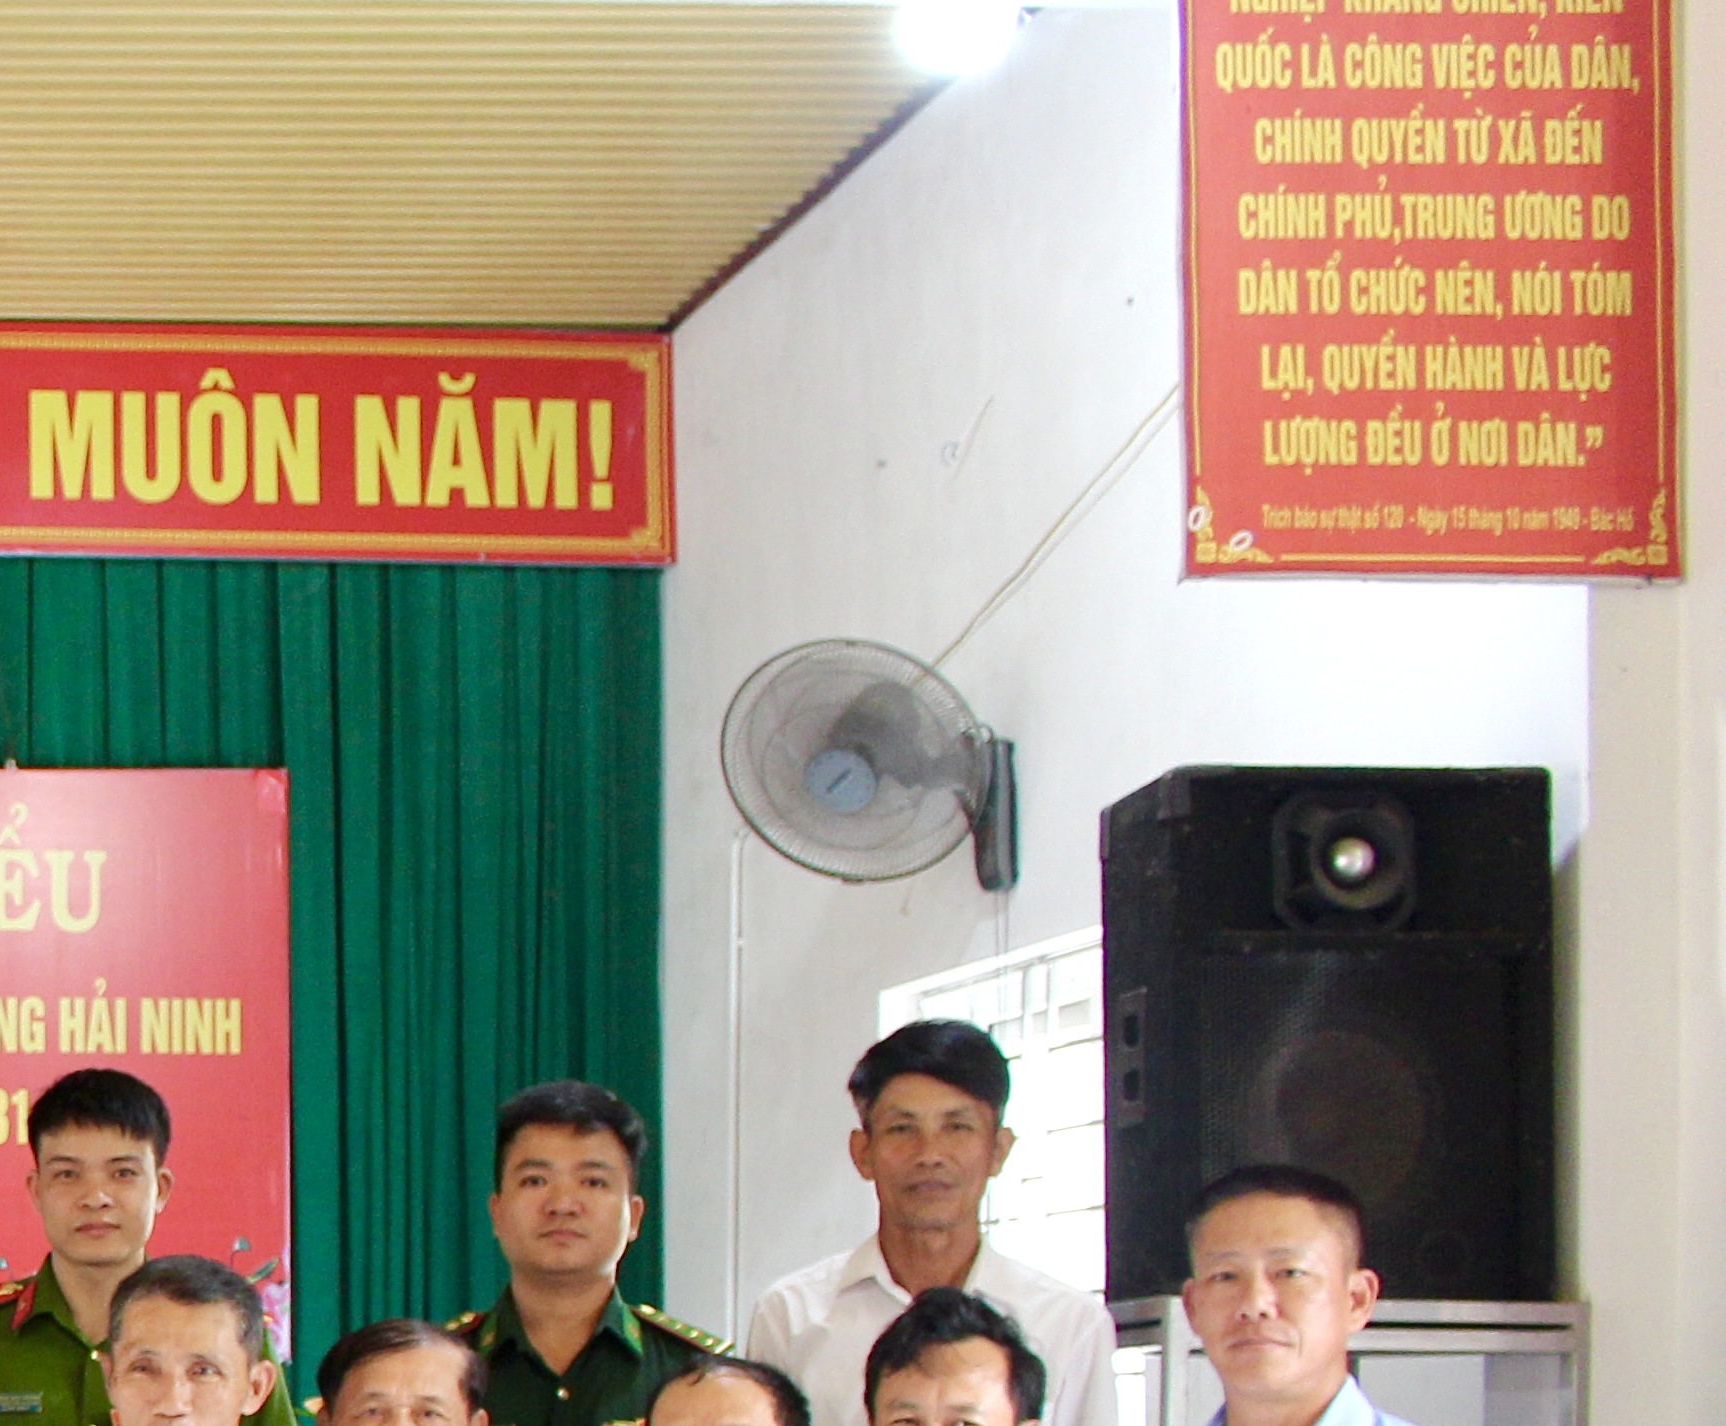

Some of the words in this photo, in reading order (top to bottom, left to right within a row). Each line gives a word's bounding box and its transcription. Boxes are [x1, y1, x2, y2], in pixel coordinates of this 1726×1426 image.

[1215, 27, 1292, 93] QUỐC
[1301, 33, 1336, 88] LÀ
[1344, 33, 1423, 89] CÔNG
[1430, 34, 1496, 99] VIỆC
[1504, 24, 1563, 89] CỦA
[1570, 34, 1639, 93] DÂN,
[1254, 108, 1343, 164] CHÍNH
[1453, 108, 1493, 164] TỪ
[1497, 111, 1536, 164] XÃ
[1543, 103, 1603, 165] ĐẾN
[1238, 184, 1326, 239] CHÍNH
[1504, 190, 1583, 240] ƯƠNG
[1591, 195, 1630, 240] DO
[1238, 258, 1297, 314] DÂN
[1305, 250, 1342, 314] TỔ
[1349, 256, 1426, 315] CHỨC
[1434, 260, 1503, 320] NÊN,
[1511, 261, 1562, 315] NÓI
[1569, 261, 1632, 316] TÓM
[1261, 344, 1314, 400] LẠI,
[1425, 335, 1504, 390] HÀNH
[1511, 336, 1550, 390] VÀ
[1557, 342, 1611, 402] LỰC
[29, 368, 320, 504] MUÔN
[355, 373, 612, 510] NĂM!
[1263, 415, 1358, 475] LƯỢNG
[1430, 401, 1452, 466] Ở
[1458, 418, 1508, 466] NƠI
[58, 977, 127, 1053] HẢI
[140, 997, 241, 1054] NINH
